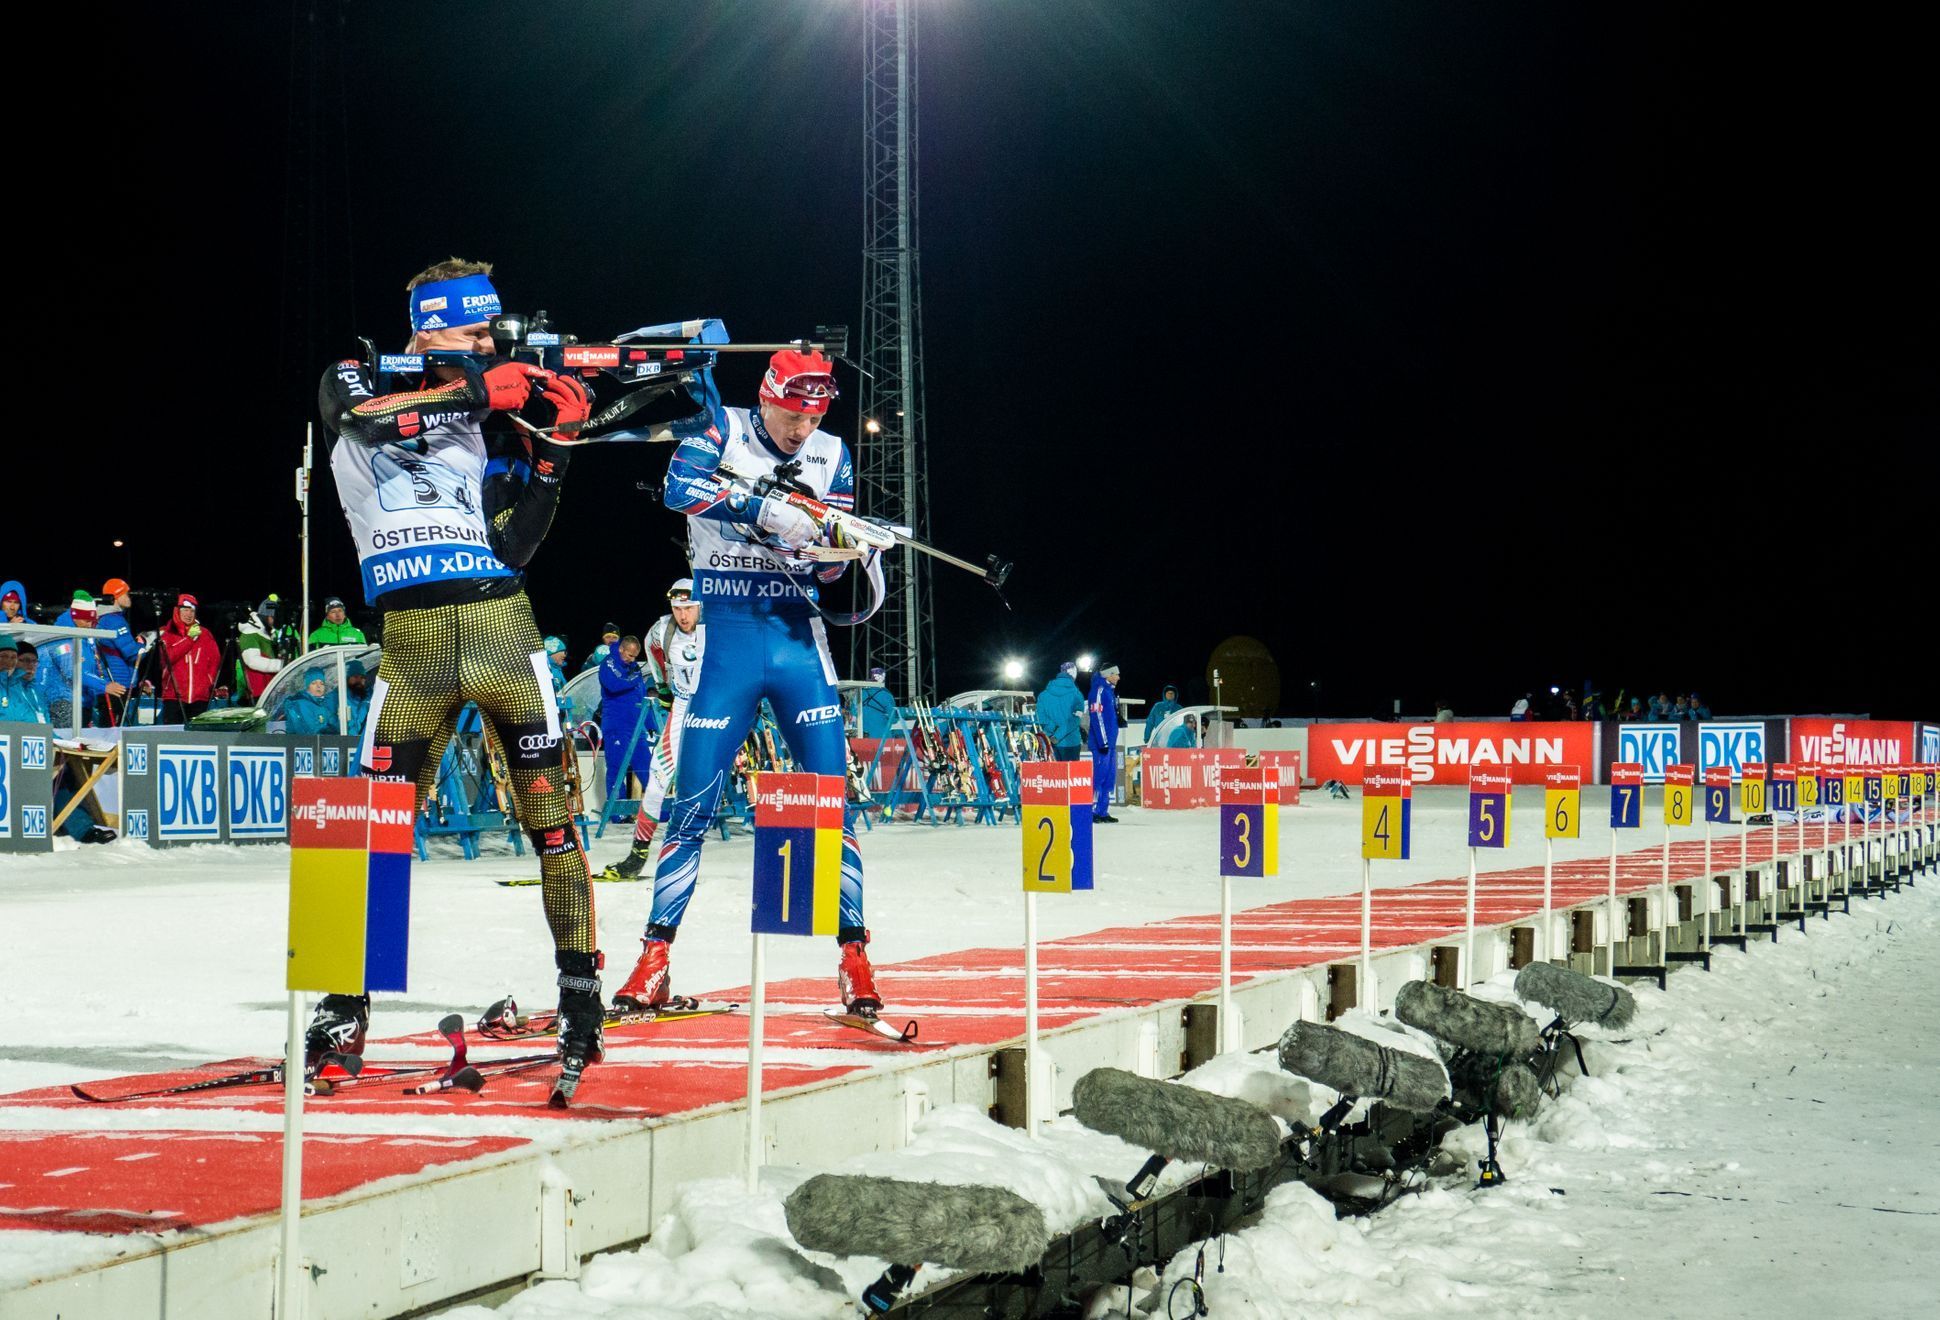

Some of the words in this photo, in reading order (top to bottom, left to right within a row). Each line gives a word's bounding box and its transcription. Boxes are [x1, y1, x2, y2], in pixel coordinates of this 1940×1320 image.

[421, 321, 448, 330] adidas
[381, 354, 422, 366] ERDINGER
[565, 351, 618, 364] VIESSMANN
[637, 363, 660, 375] DKB
[806, 455, 828, 465] BMW
[372, 555, 432, 586] BMW
[702, 577, 752, 597] BMW
[795, 703, 842, 724] ATEX
[22, 740, 45, 765] DKB
[127, 748, 147, 770] DKB
[295, 752, 312, 772] DKB
[322, 752, 339, 771] DKB
[1331, 726, 1563, 782] VIESSMANN
[1621, 732, 1681, 774] DKB
[1701, 731, 1763, 774] DKB
[1023, 774, 1068, 794] VIESSMANN
[1221, 778, 1262, 795] VIESSMANN
[1363, 774, 1401, 789] VIESSMANN
[1471, 773, 1506, 786] VIESSMANN
[1801, 780, 1813, 802] 12
[1848, 780, 1861, 799] 14
[1867, 779, 1880, 799] 15
[1884, 778, 1896, 796] 16
[160, 759, 217, 825] DKB
[230, 760, 284, 825] DKB
[1745, 783, 1761, 809] 10
[1776, 783, 1791, 808] 11
[1827, 780, 1841, 803] 13
[293, 798, 367, 829] VIESSMANN
[1555, 796, 1568, 832] 6
[1619, 789, 1632, 824] 7
[1672, 790, 1683, 820] 8
[1712, 789, 1725, 818] 9
[23, 810, 46, 835] DKB
[128, 814, 147, 837] DKB
[1373, 804, 1390, 851] 4
[1479, 799, 1495, 841] 5
[1038, 817, 1055, 881] 2
[1233, 812, 1251, 868] 3
[778, 839, 792, 922] 1
[620, 1013, 657, 1026] FISCHER
